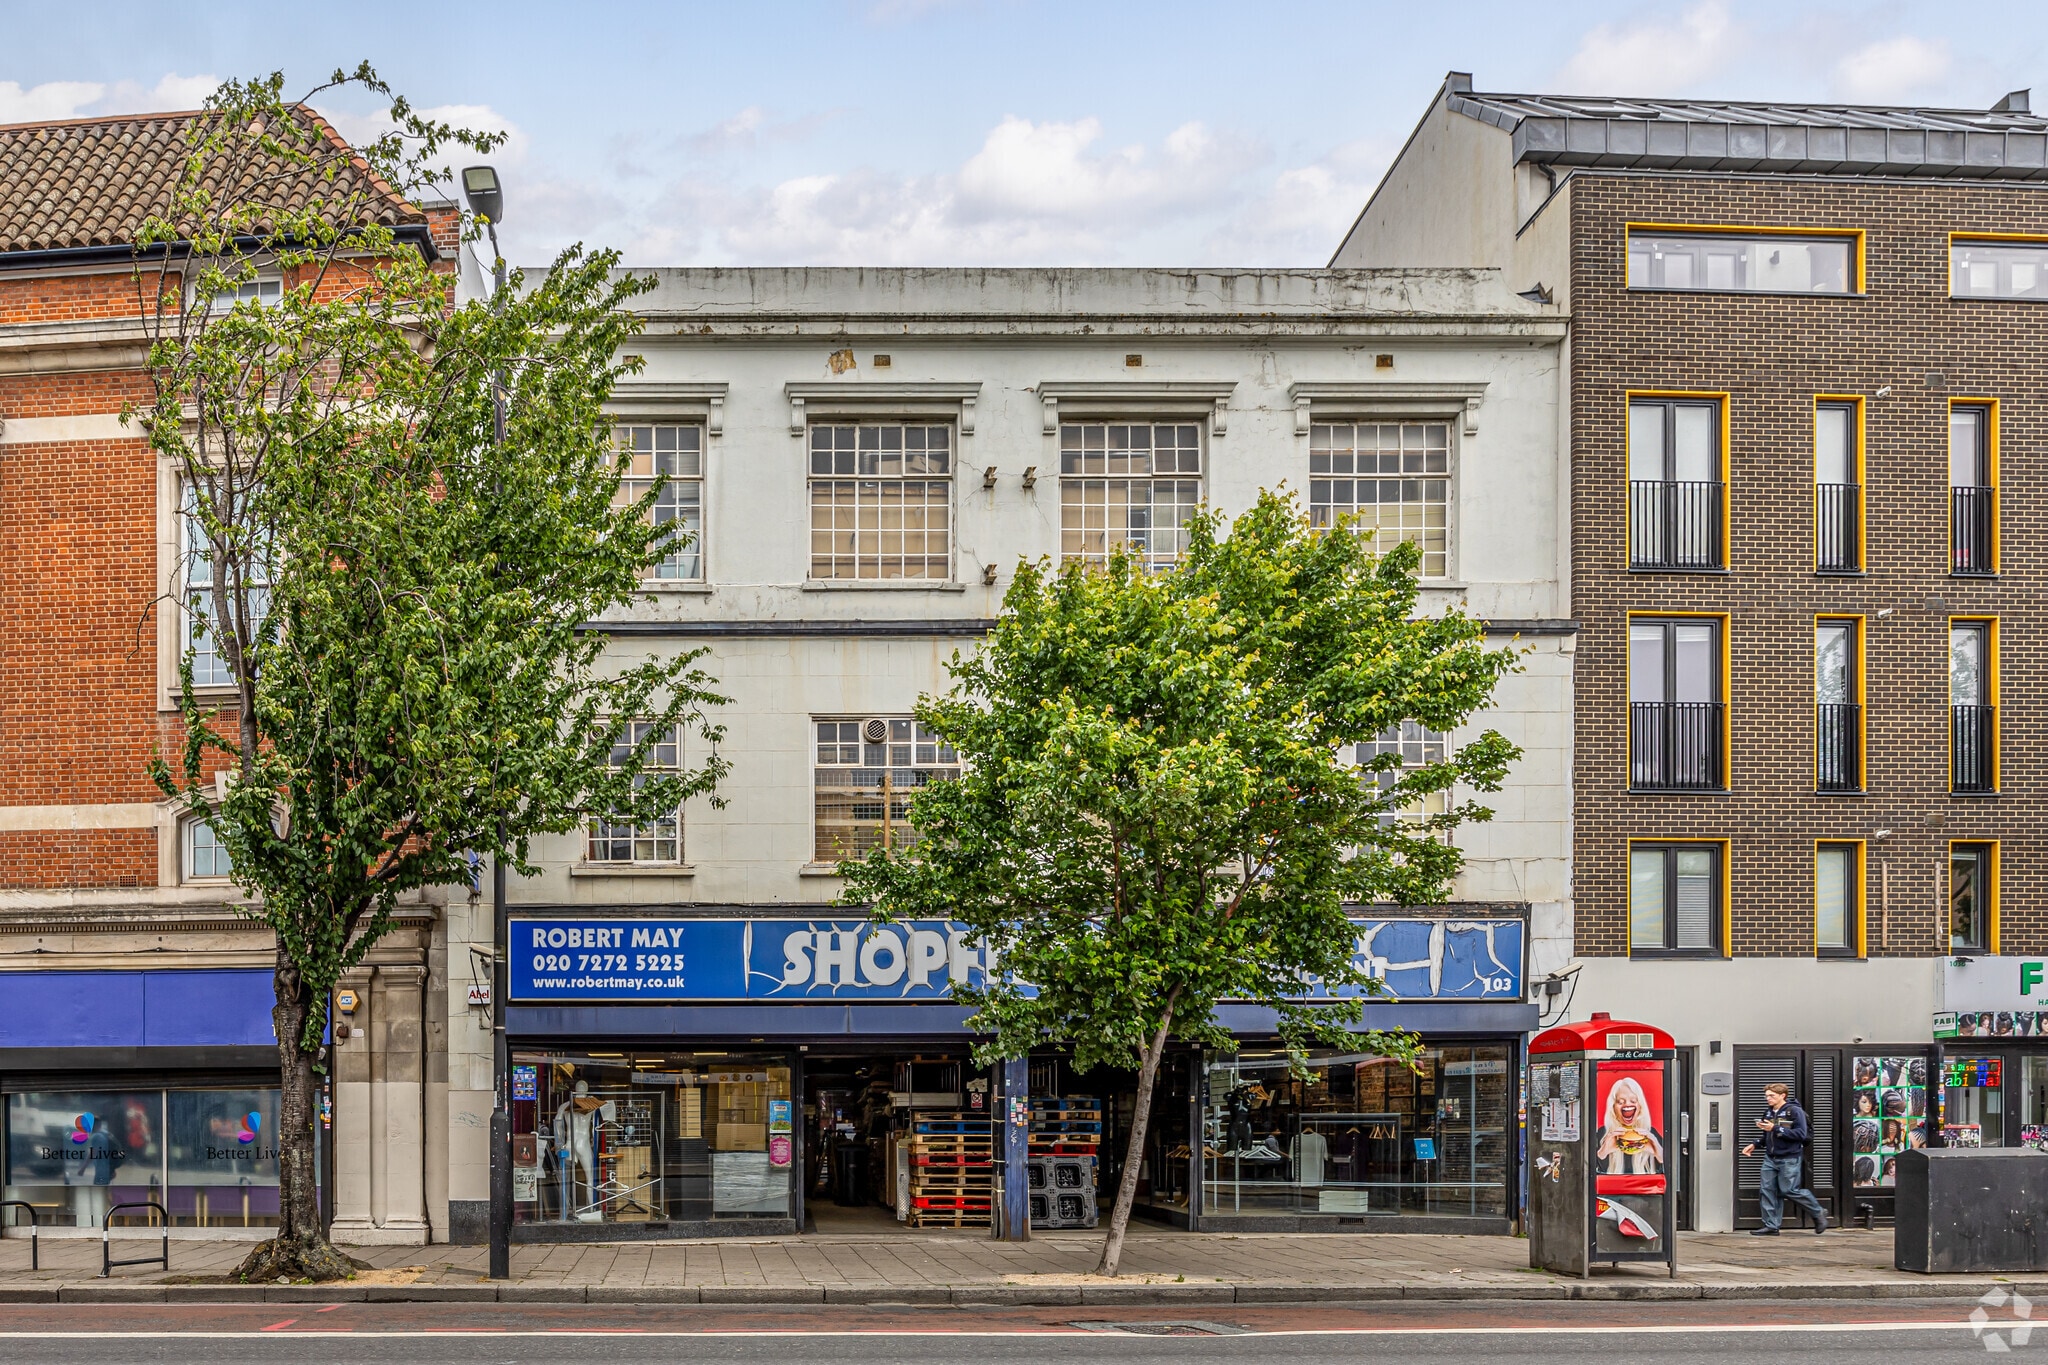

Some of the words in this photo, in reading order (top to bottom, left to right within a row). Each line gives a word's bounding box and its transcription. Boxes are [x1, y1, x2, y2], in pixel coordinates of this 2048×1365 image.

[532, 928, 624, 948] ROBERT
[631, 928, 684, 948] MAY
[533, 955, 571, 971] 020
[578, 955, 628, 971] 7272
[635, 955, 685, 972] 5225
[533, 975, 685, 991] www.robertmay.co.uk
[1482, 977, 1512, 992] 103
[1934, 1017, 1955, 1026] FABI
[1633, 1050, 1653, 1058] Cards
[1945, 1073, 1969, 1087] abi
[42, 1147, 85, 1160] Better
[89, 1146, 126, 1160] Lives
[207, 1146, 251, 1160] Better
[256, 1146, 280, 1160] Liv
